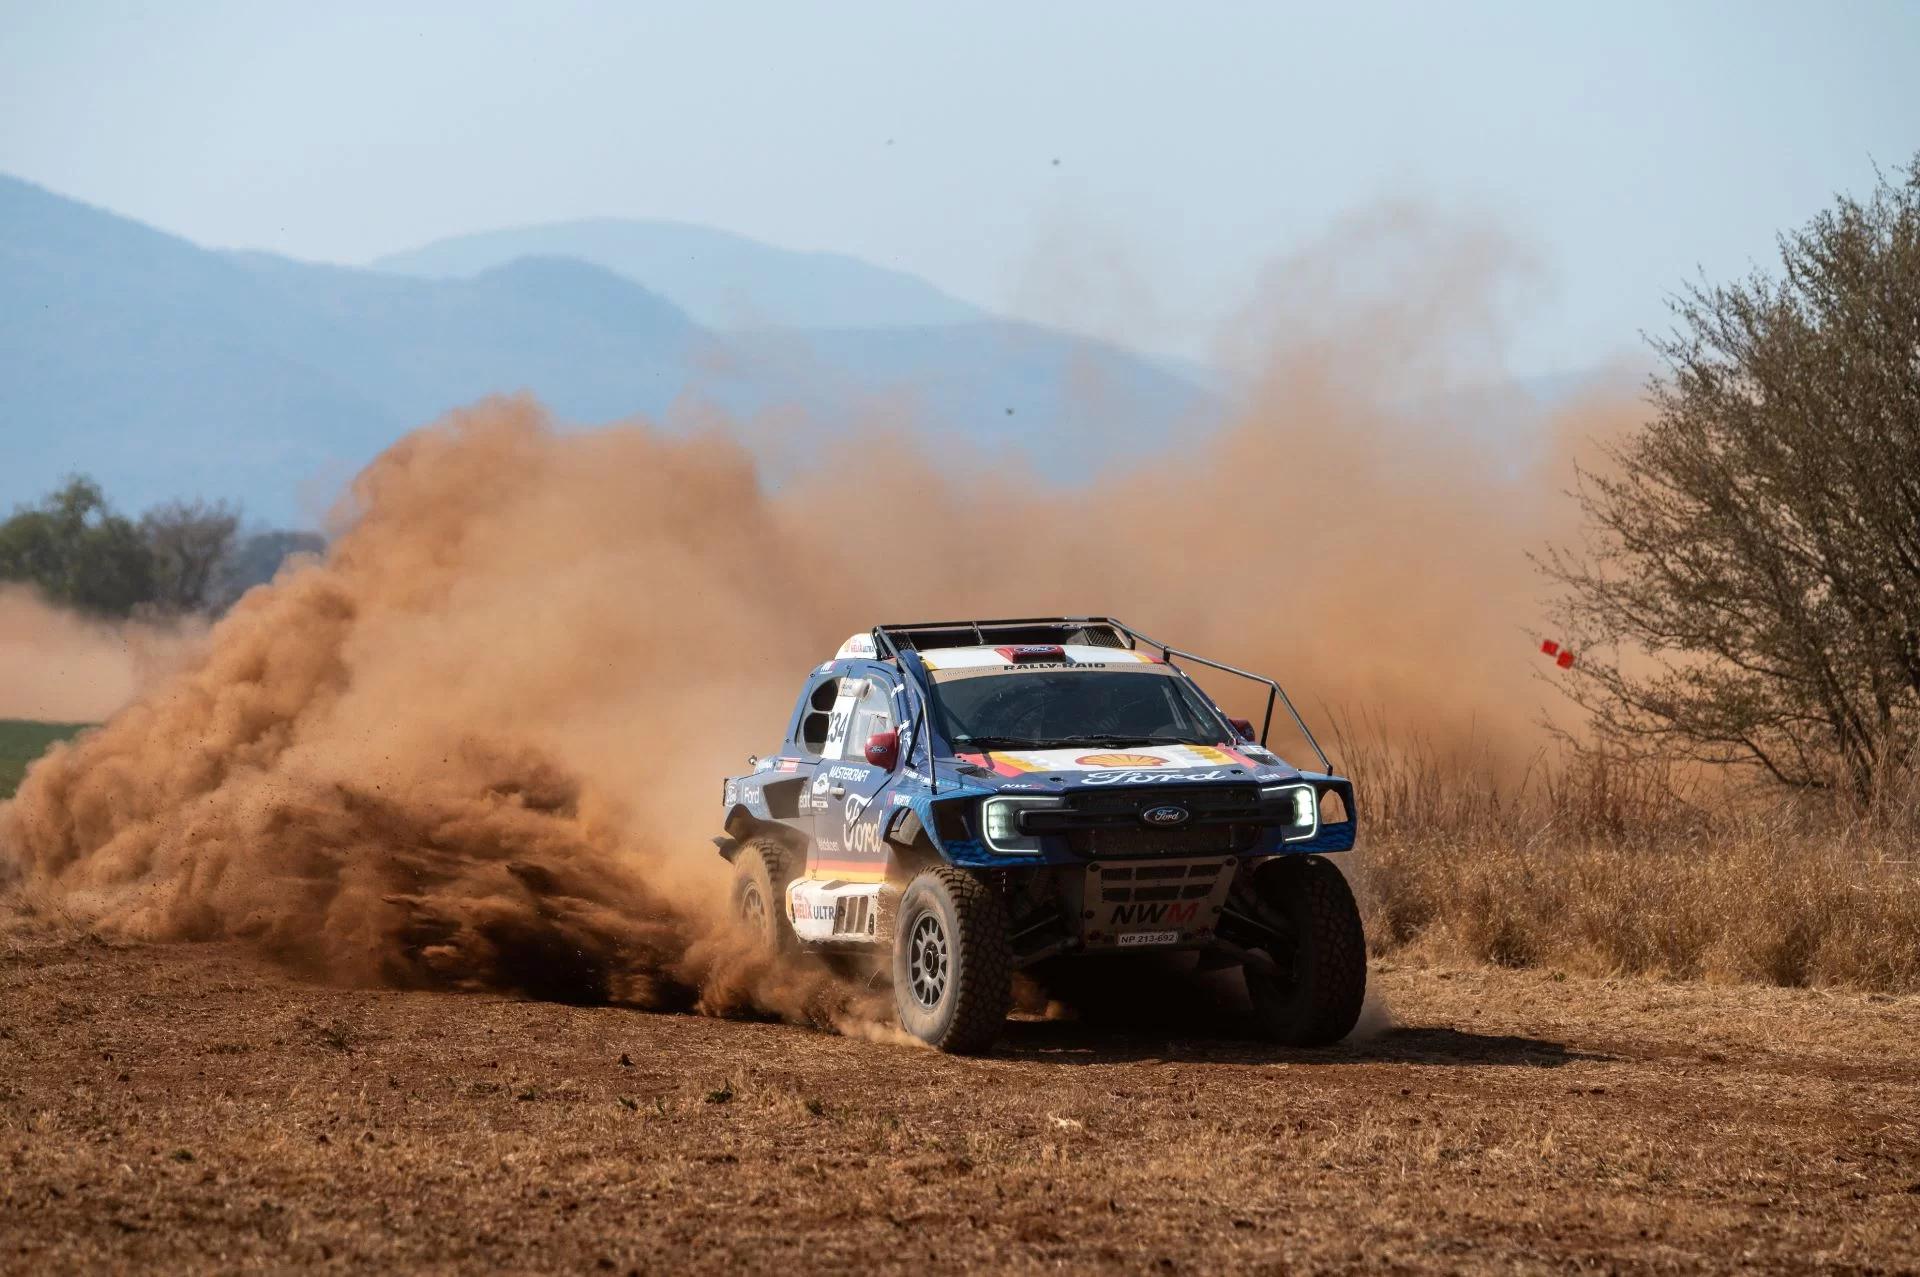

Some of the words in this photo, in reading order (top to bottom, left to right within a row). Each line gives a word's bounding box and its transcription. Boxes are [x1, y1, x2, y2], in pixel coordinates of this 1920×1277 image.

[1003, 662, 1106, 671] RALLY-RAID
[829, 765, 870, 782] MASTERCRAFT
[1081, 769, 1226, 785] Ford
[744, 787, 760, 804] Ford
[843, 793, 883, 853] Ford
[1154, 809, 1179, 822] Ford
[1110, 902, 1200, 925] NWM
[1121, 935, 1136, 944] NP
[1138, 934, 1175, 943] 213-692
